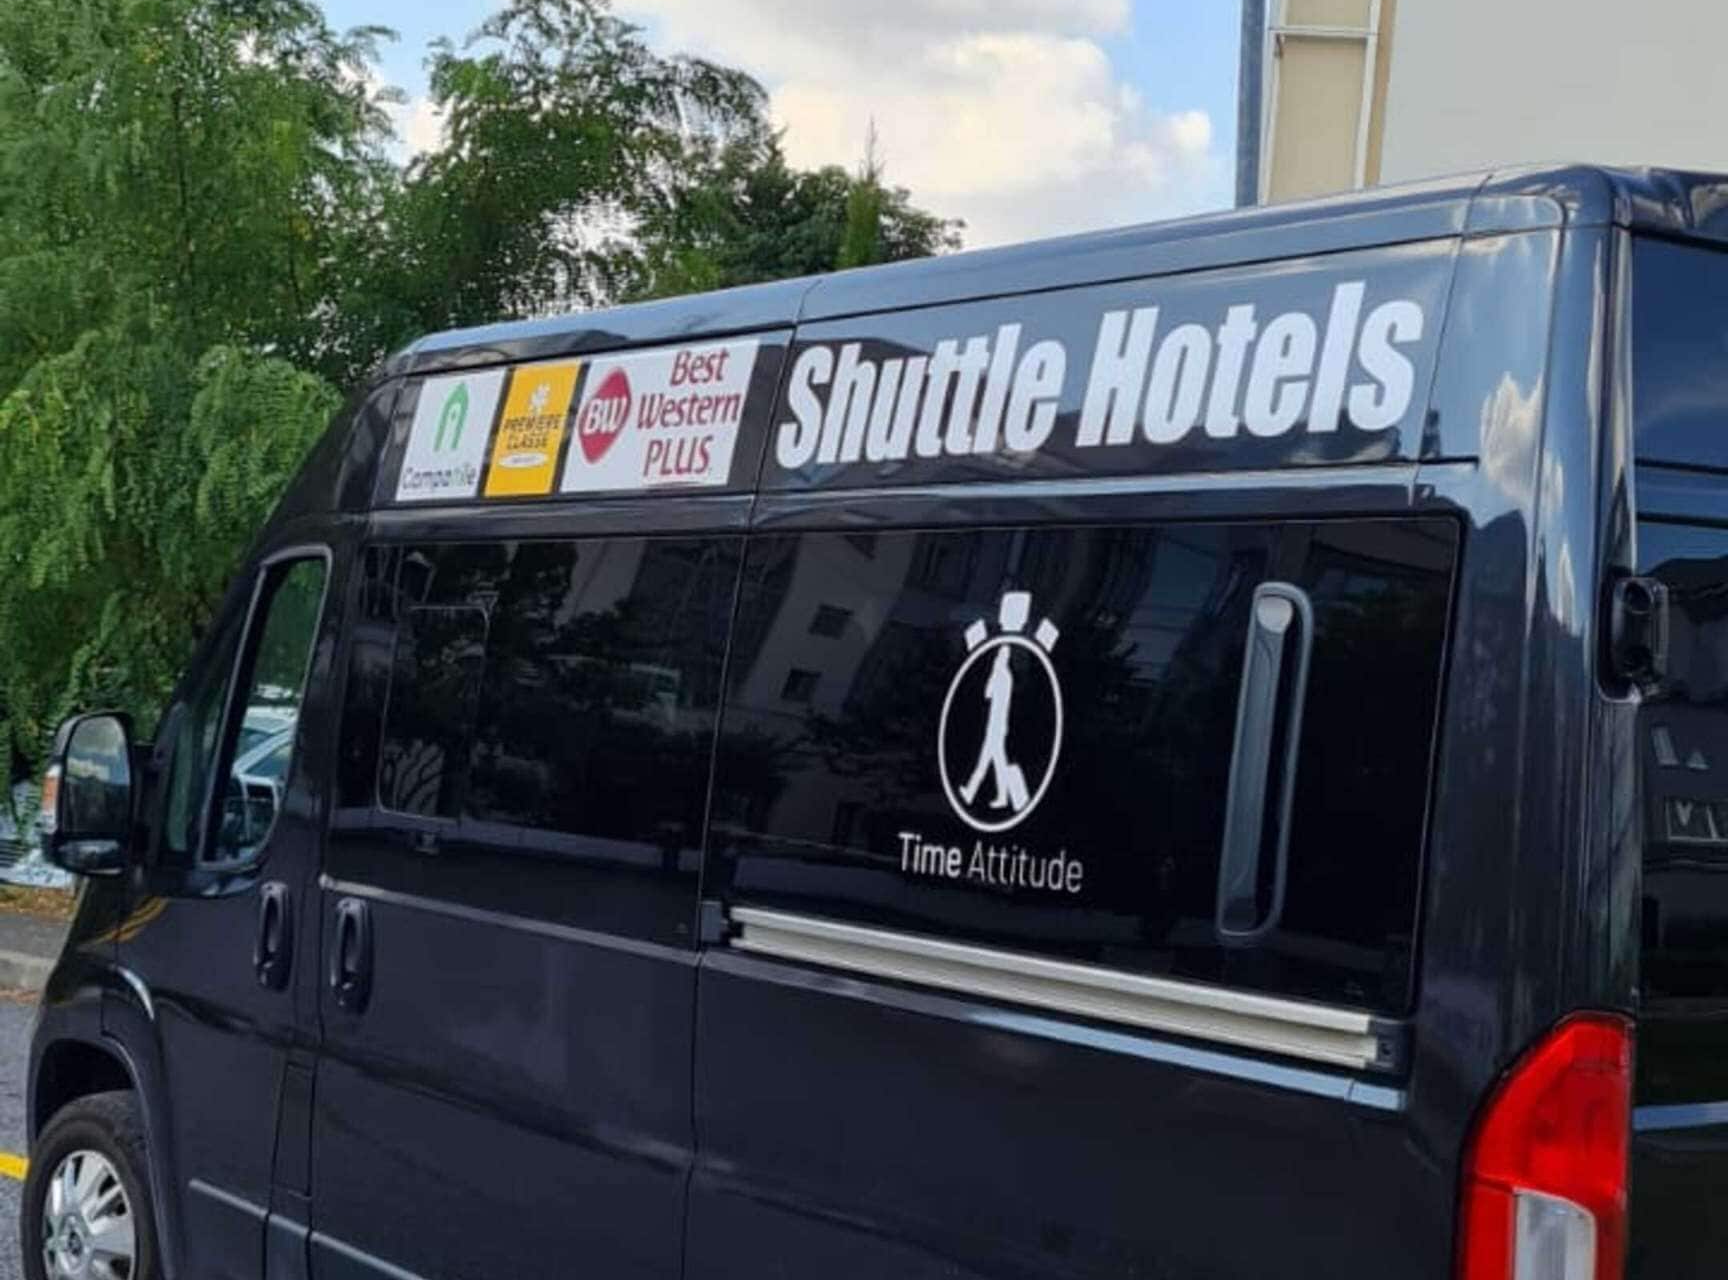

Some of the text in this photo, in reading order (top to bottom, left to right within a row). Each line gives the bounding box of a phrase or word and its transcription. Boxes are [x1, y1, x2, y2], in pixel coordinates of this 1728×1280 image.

[669, 348, 730, 387] Best
[775, 281, 1424, 469] Shuttle Hotels
[582, 397, 627, 437] BW
[636, 392, 742, 430] Western
[643, 435, 714, 477] PLUS
[899, 832, 1085, 894] Time Attitude
